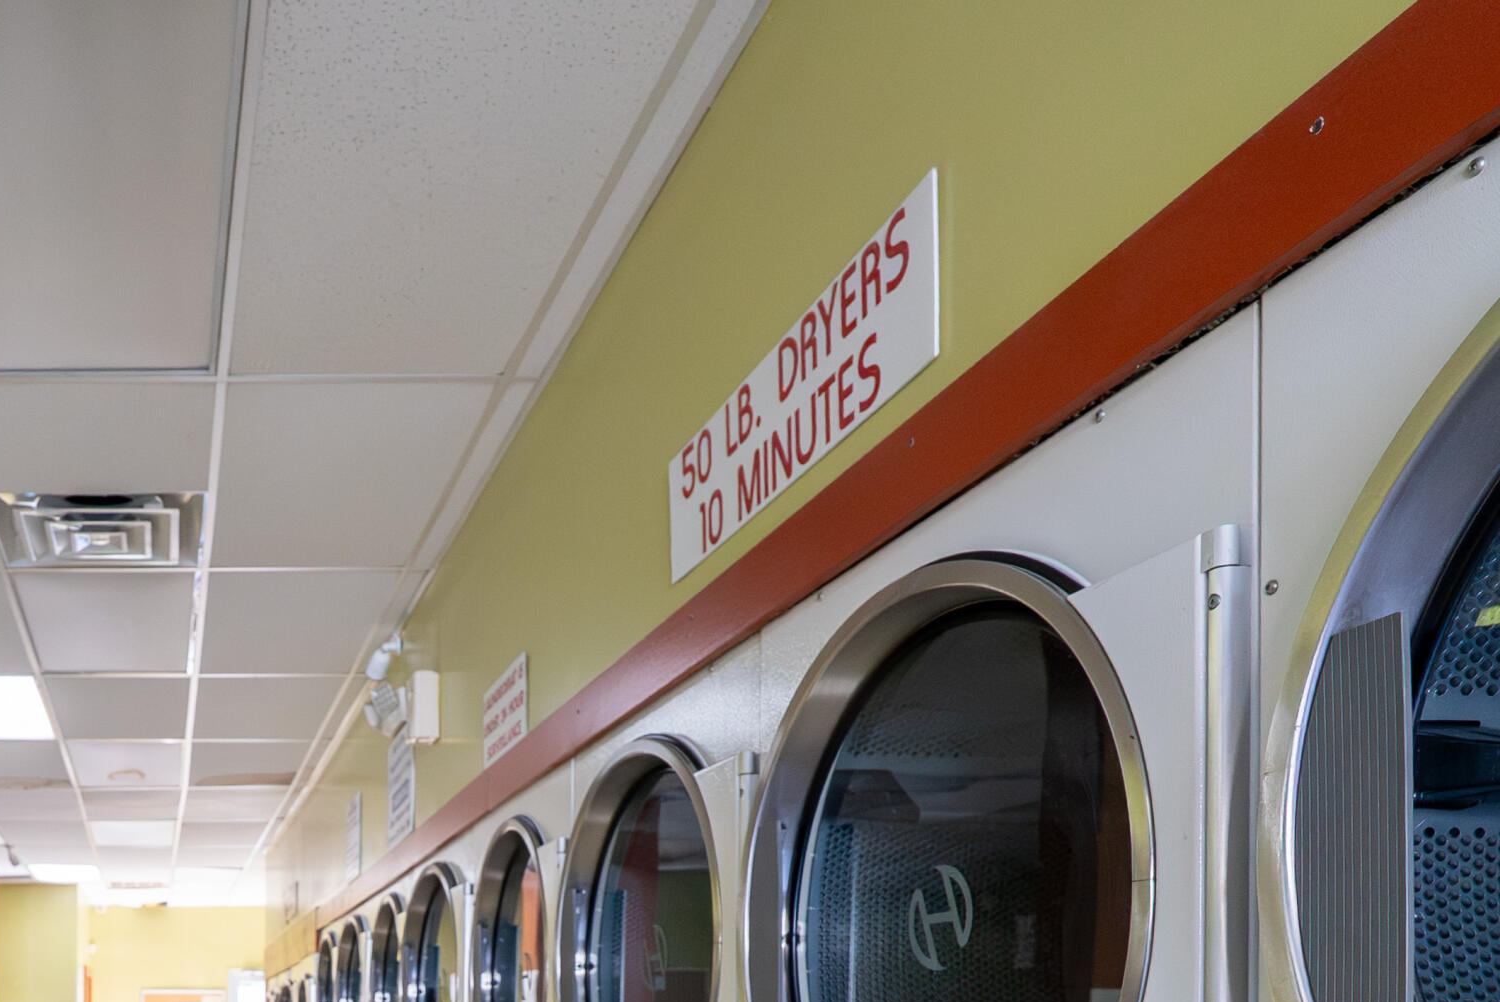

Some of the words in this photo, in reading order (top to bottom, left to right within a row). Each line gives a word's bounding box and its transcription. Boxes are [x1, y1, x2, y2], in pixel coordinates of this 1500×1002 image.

[682, 429, 712, 499] 50
[725, 384, 762, 458] LB.
[778, 207, 911, 403] DRYERS
[699, 489, 724, 553] 10
[738, 333, 882, 521] MINUTES
